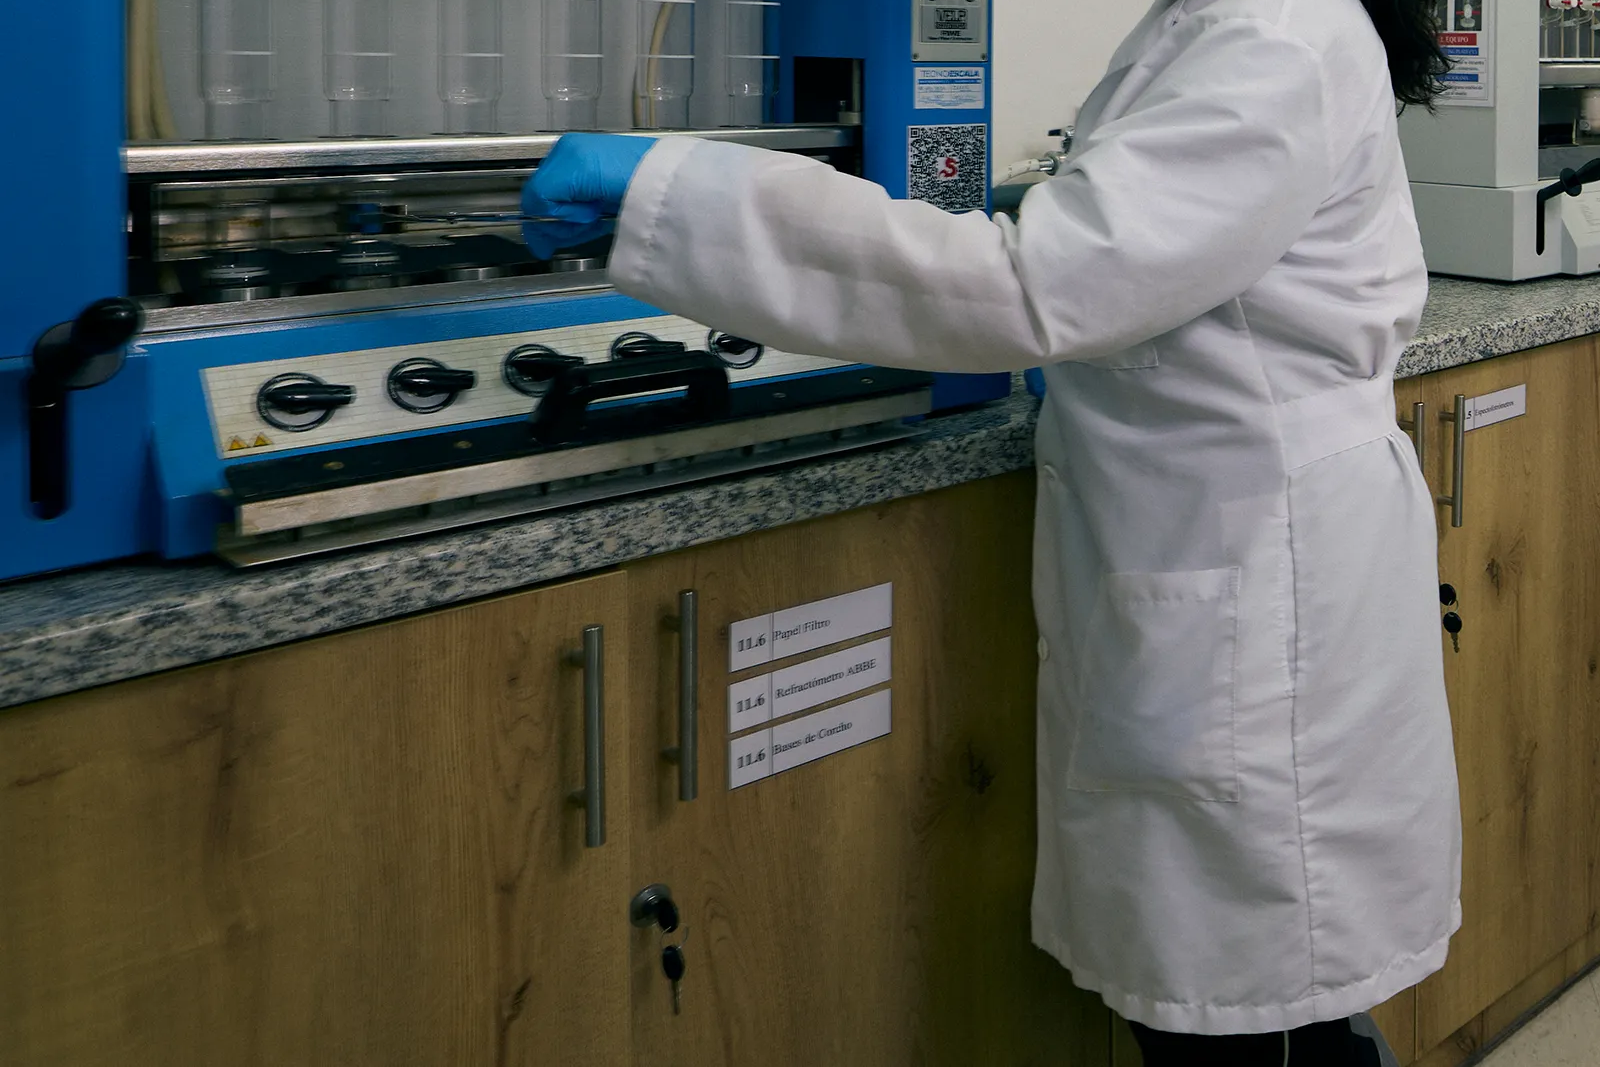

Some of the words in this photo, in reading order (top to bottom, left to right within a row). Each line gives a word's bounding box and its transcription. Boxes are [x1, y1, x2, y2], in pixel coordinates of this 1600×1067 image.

[738, 633, 766, 653] 11.6
[773, 625, 801, 641] Papel
[802, 619, 831, 633] Filtro
[736, 693, 766, 714] 11.6
[775, 671, 845, 699] Refractómetro
[846, 658, 877, 677] ABBE
[737, 748, 767, 770] 11.6
[772, 738, 802, 756] Bases
[804, 733, 816, 745] de
[816, 721, 853, 740] Corcho
